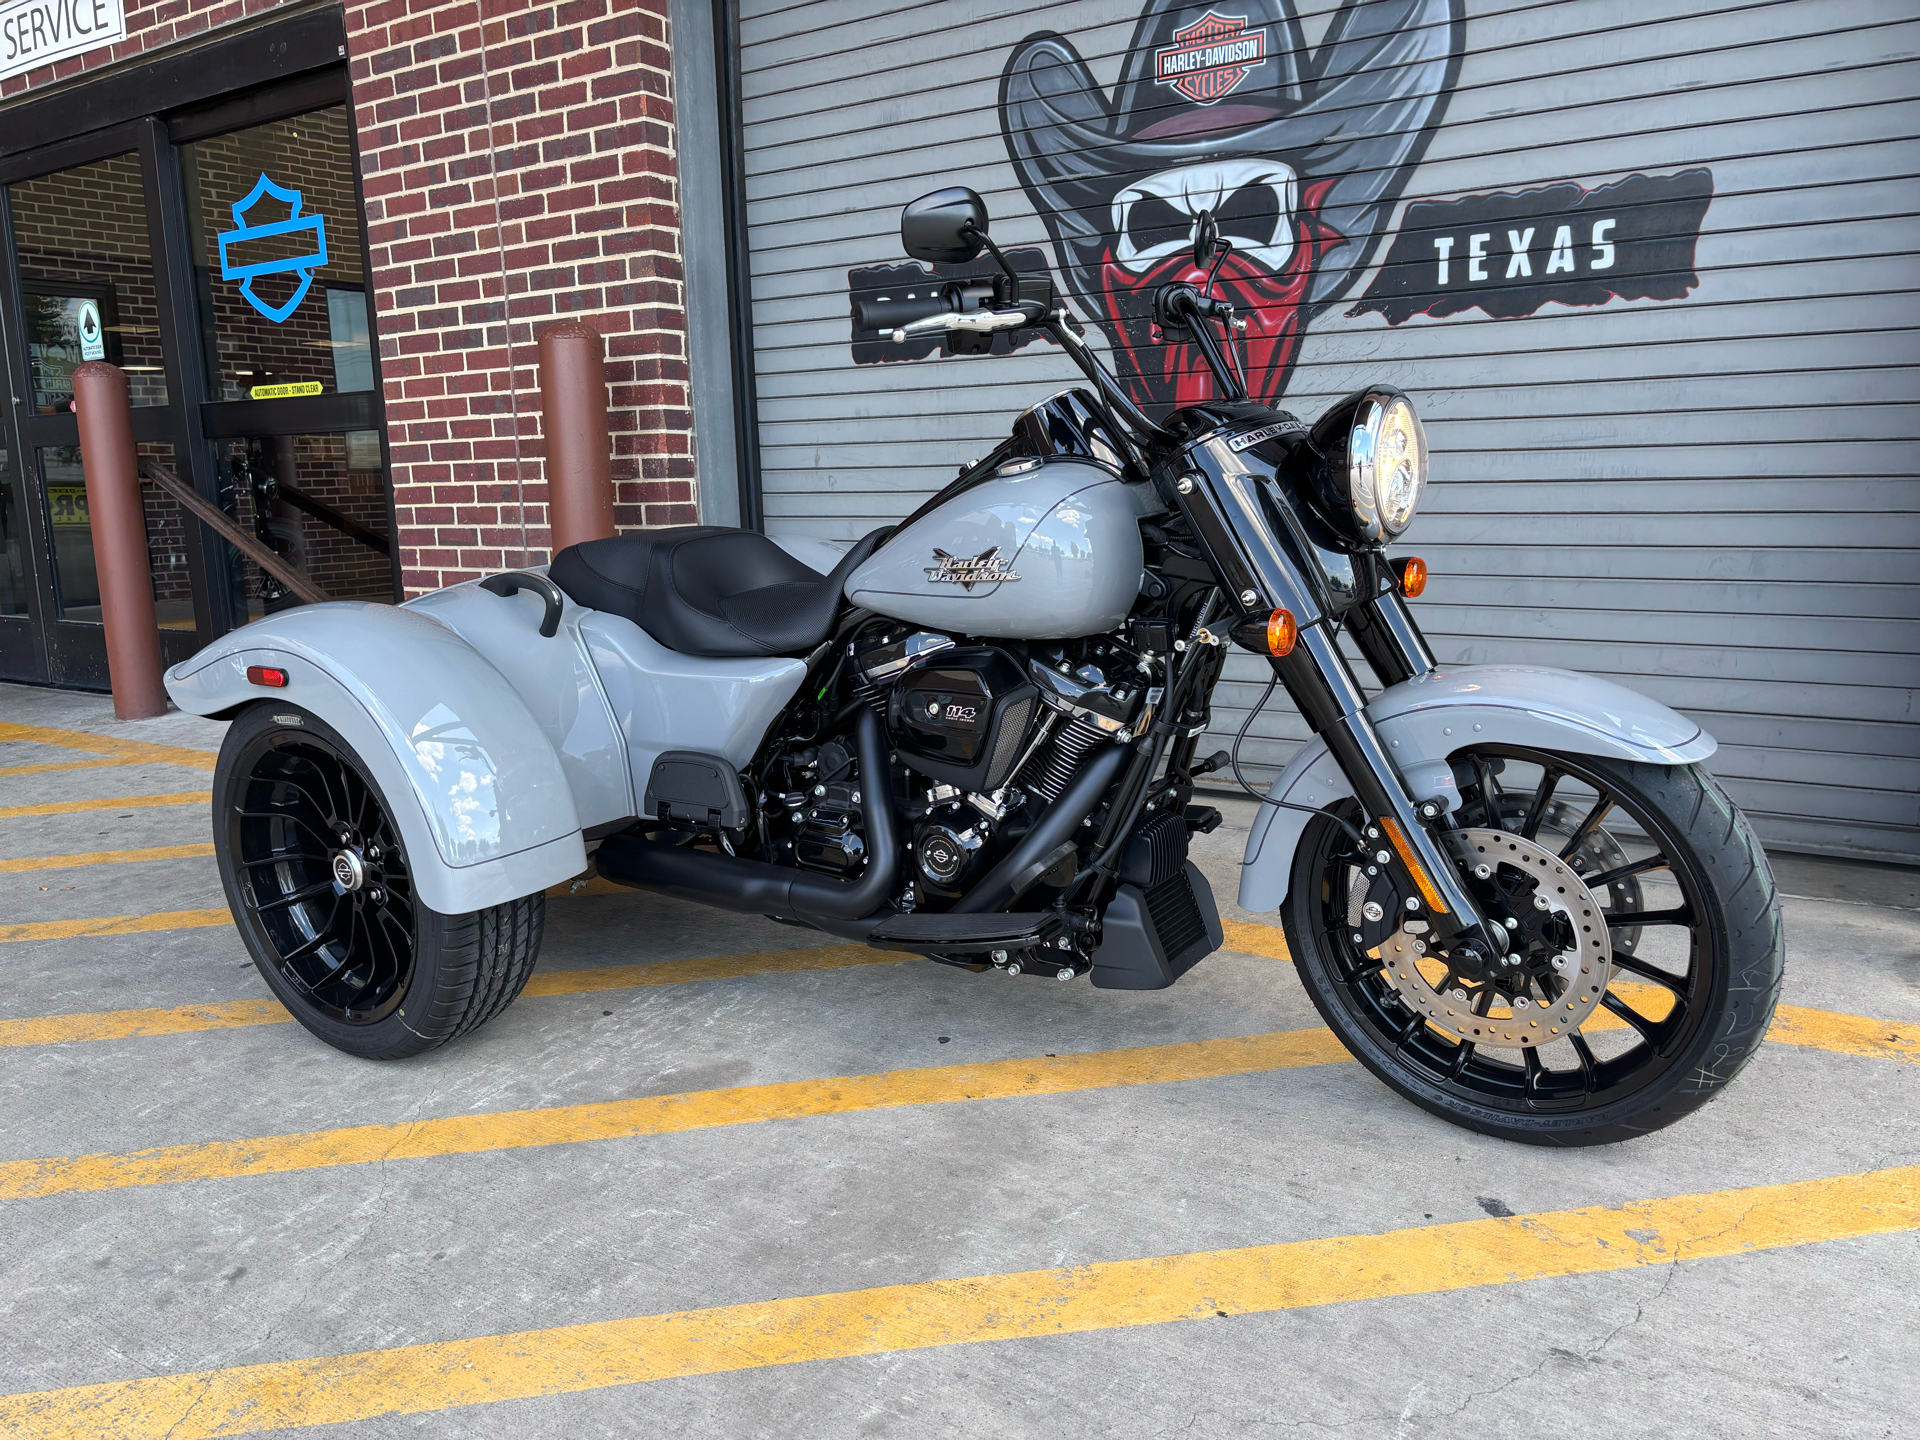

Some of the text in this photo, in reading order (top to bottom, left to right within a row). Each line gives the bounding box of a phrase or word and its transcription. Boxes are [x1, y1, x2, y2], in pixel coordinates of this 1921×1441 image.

[4, 0, 108, 60] SERVICE
[1185, 21, 1236, 46] MOTOR
[1163, 39, 1258, 74] HARLEY-DAVIDSON
[1184, 68, 1234, 97] CYCLES
[1434, 218, 1616, 285] TEXAS
[946, 705, 976, 719] 114
